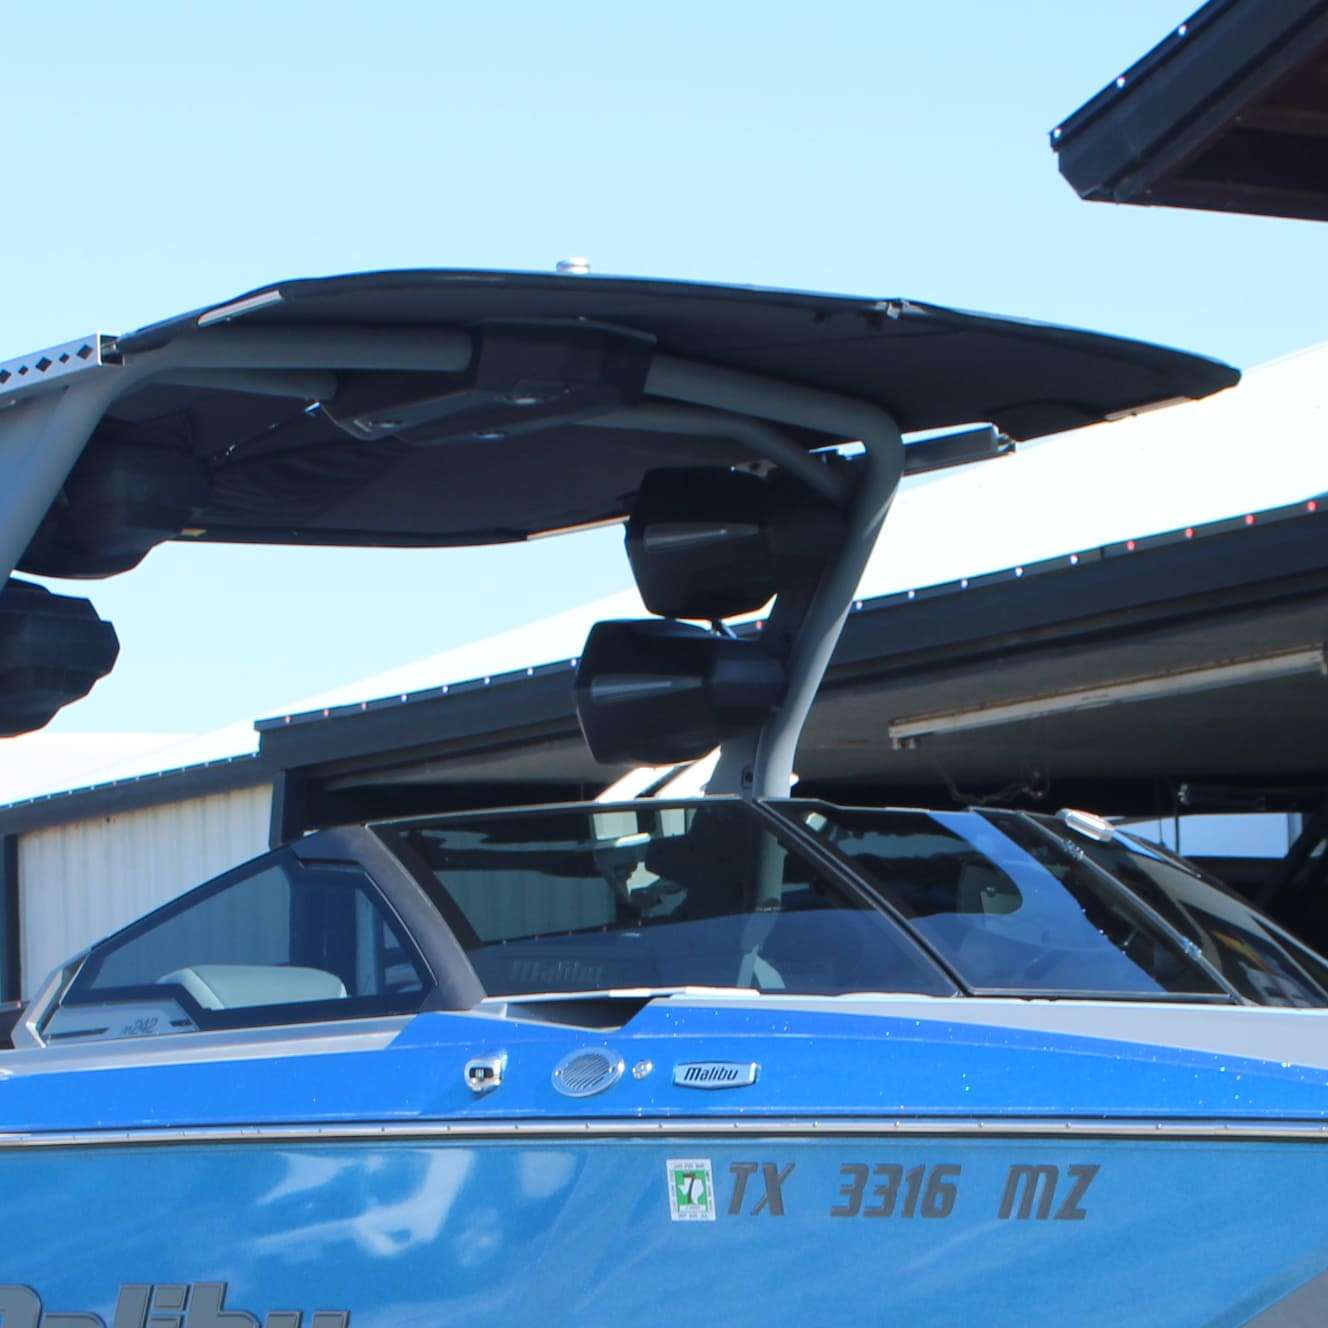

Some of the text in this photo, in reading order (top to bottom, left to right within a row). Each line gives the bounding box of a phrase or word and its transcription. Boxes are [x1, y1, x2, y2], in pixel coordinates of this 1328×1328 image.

[683, 1066, 739, 1082] Malibu
[726, 1161, 1101, 1220] TX 3316 MZ
